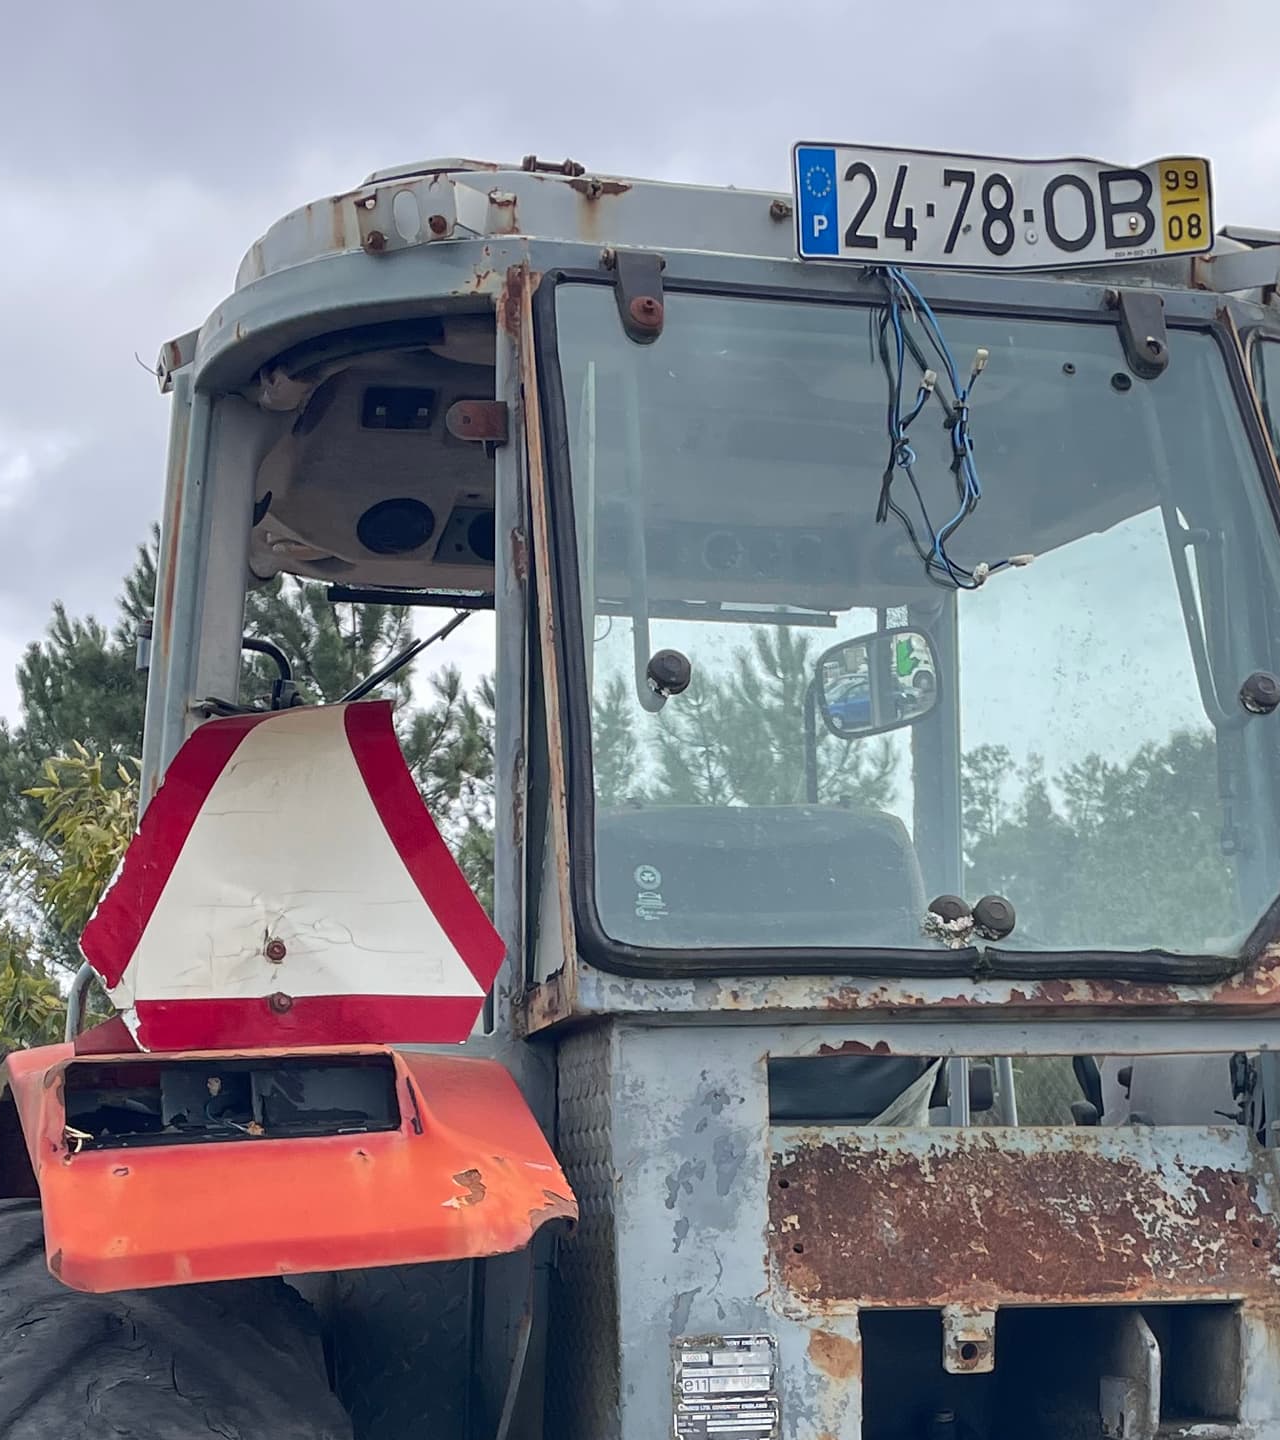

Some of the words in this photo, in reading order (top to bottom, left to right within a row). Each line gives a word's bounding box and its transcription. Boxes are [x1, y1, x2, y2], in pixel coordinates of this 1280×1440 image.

[1164, 168, 1201, 191] 99
[812, 214, 829, 238] P
[1167, 212, 1203, 242] 08
[683, 1379, 708, 1392] e11
